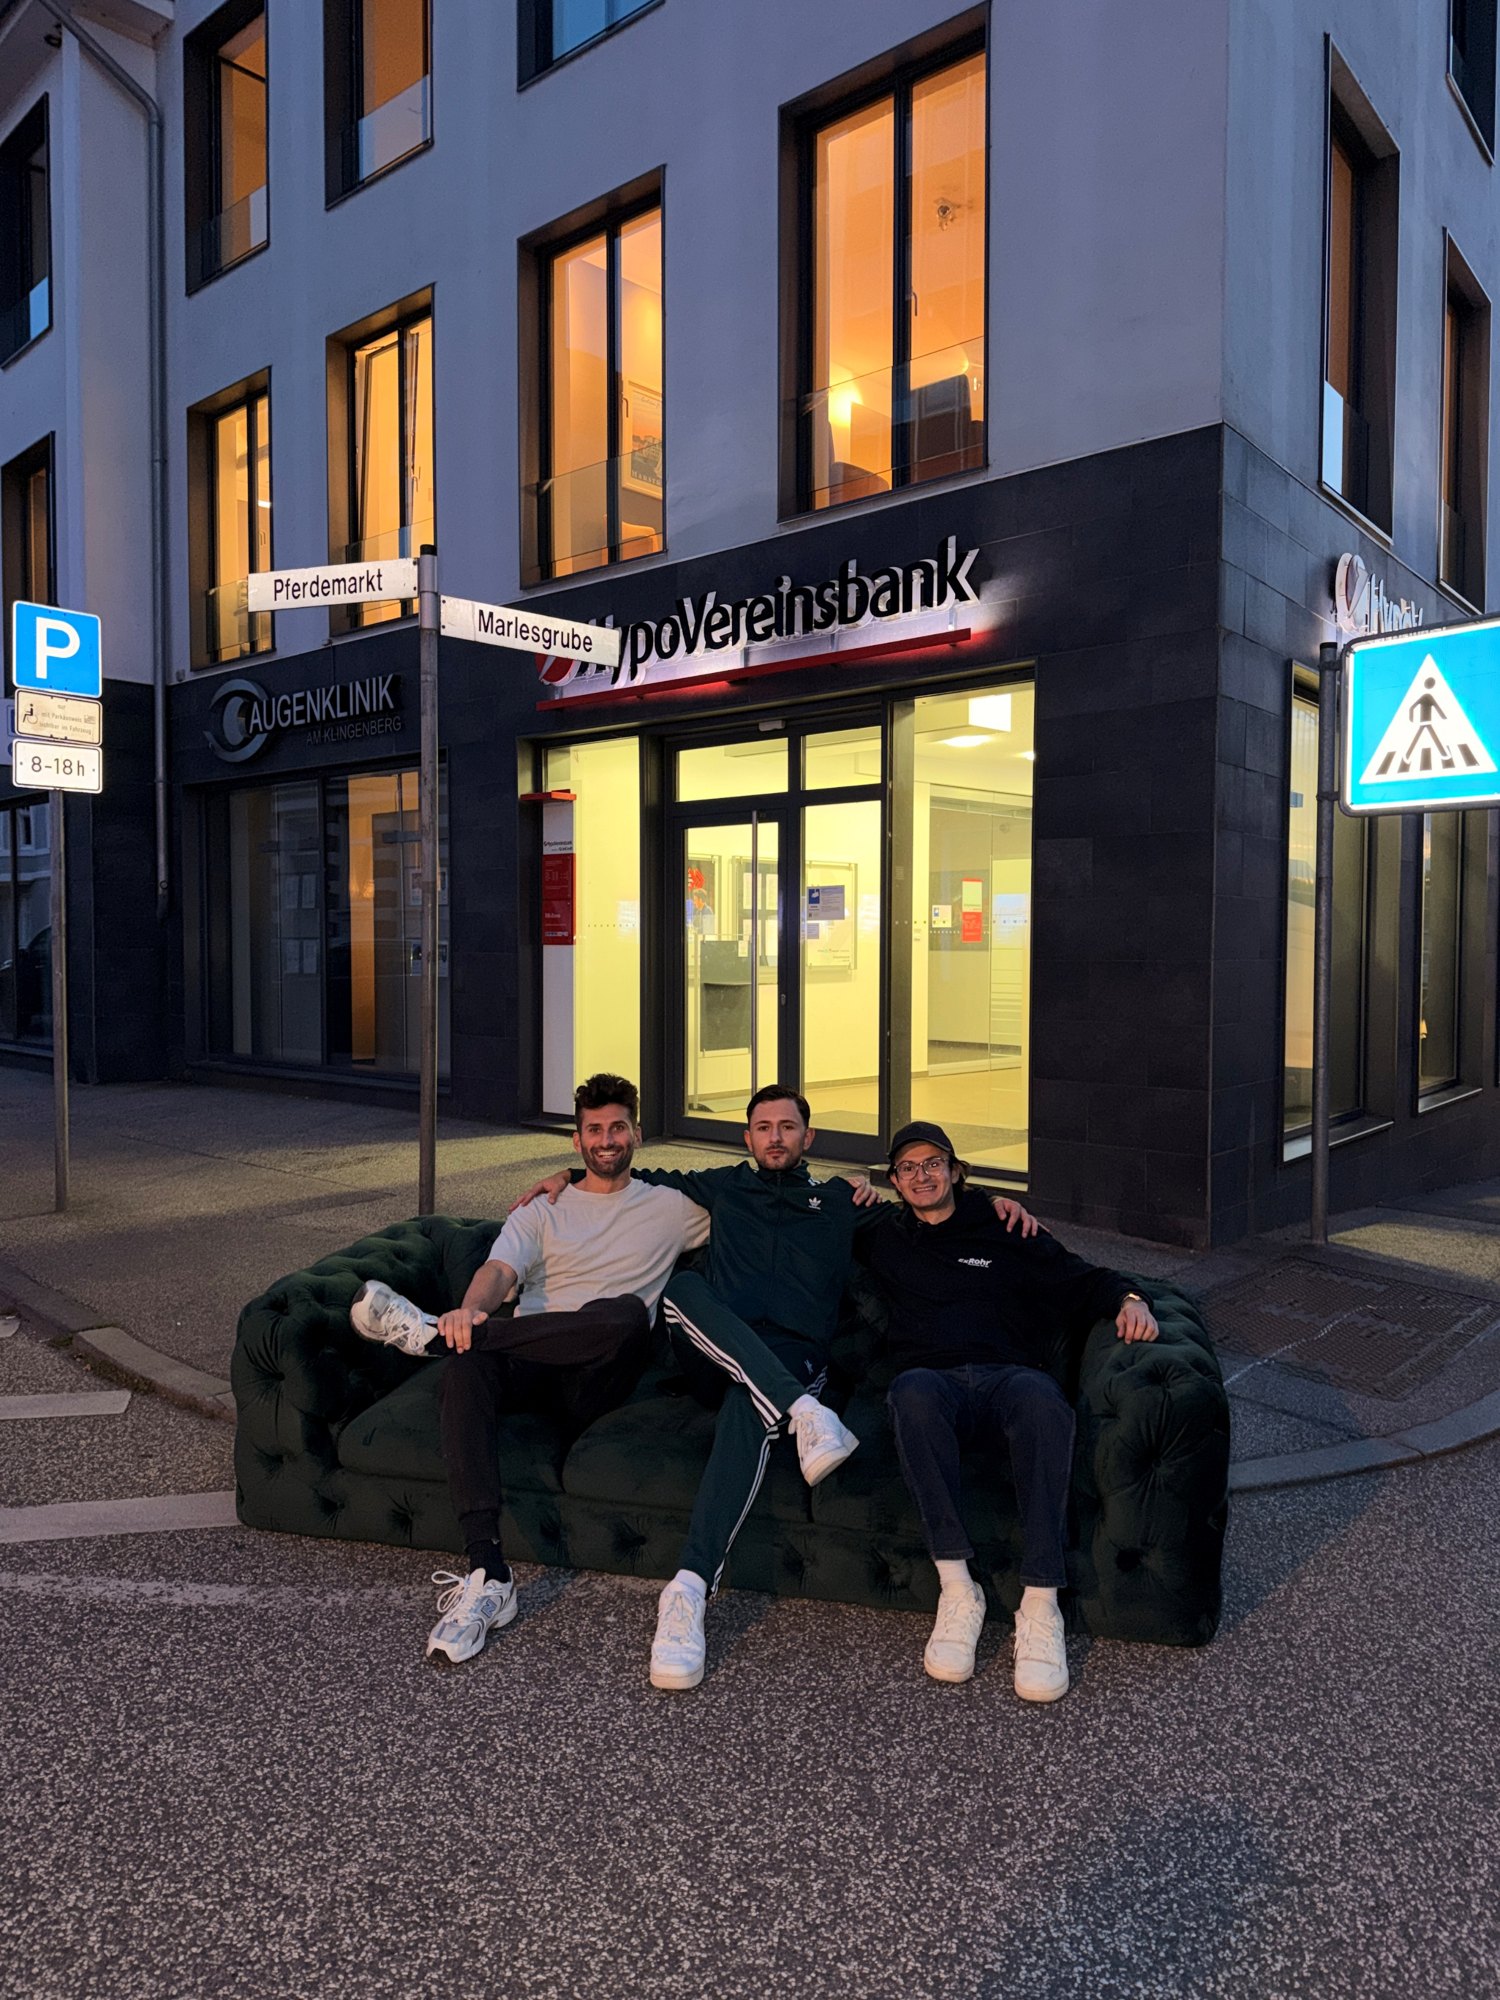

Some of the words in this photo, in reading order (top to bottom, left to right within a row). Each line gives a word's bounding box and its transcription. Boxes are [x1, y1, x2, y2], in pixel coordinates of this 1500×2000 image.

[274, 569, 382, 601] Pferdemarkt
[578, 535, 980, 686] ypoVereinsbank
[36, 617, 80, 679] P
[478, 609, 593, 653] Marlesgrube
[249, 673, 395, 734] AUGENKLINIK
[306, 730, 320, 746] AM
[323, 716, 402, 743] KLINGENBERG
